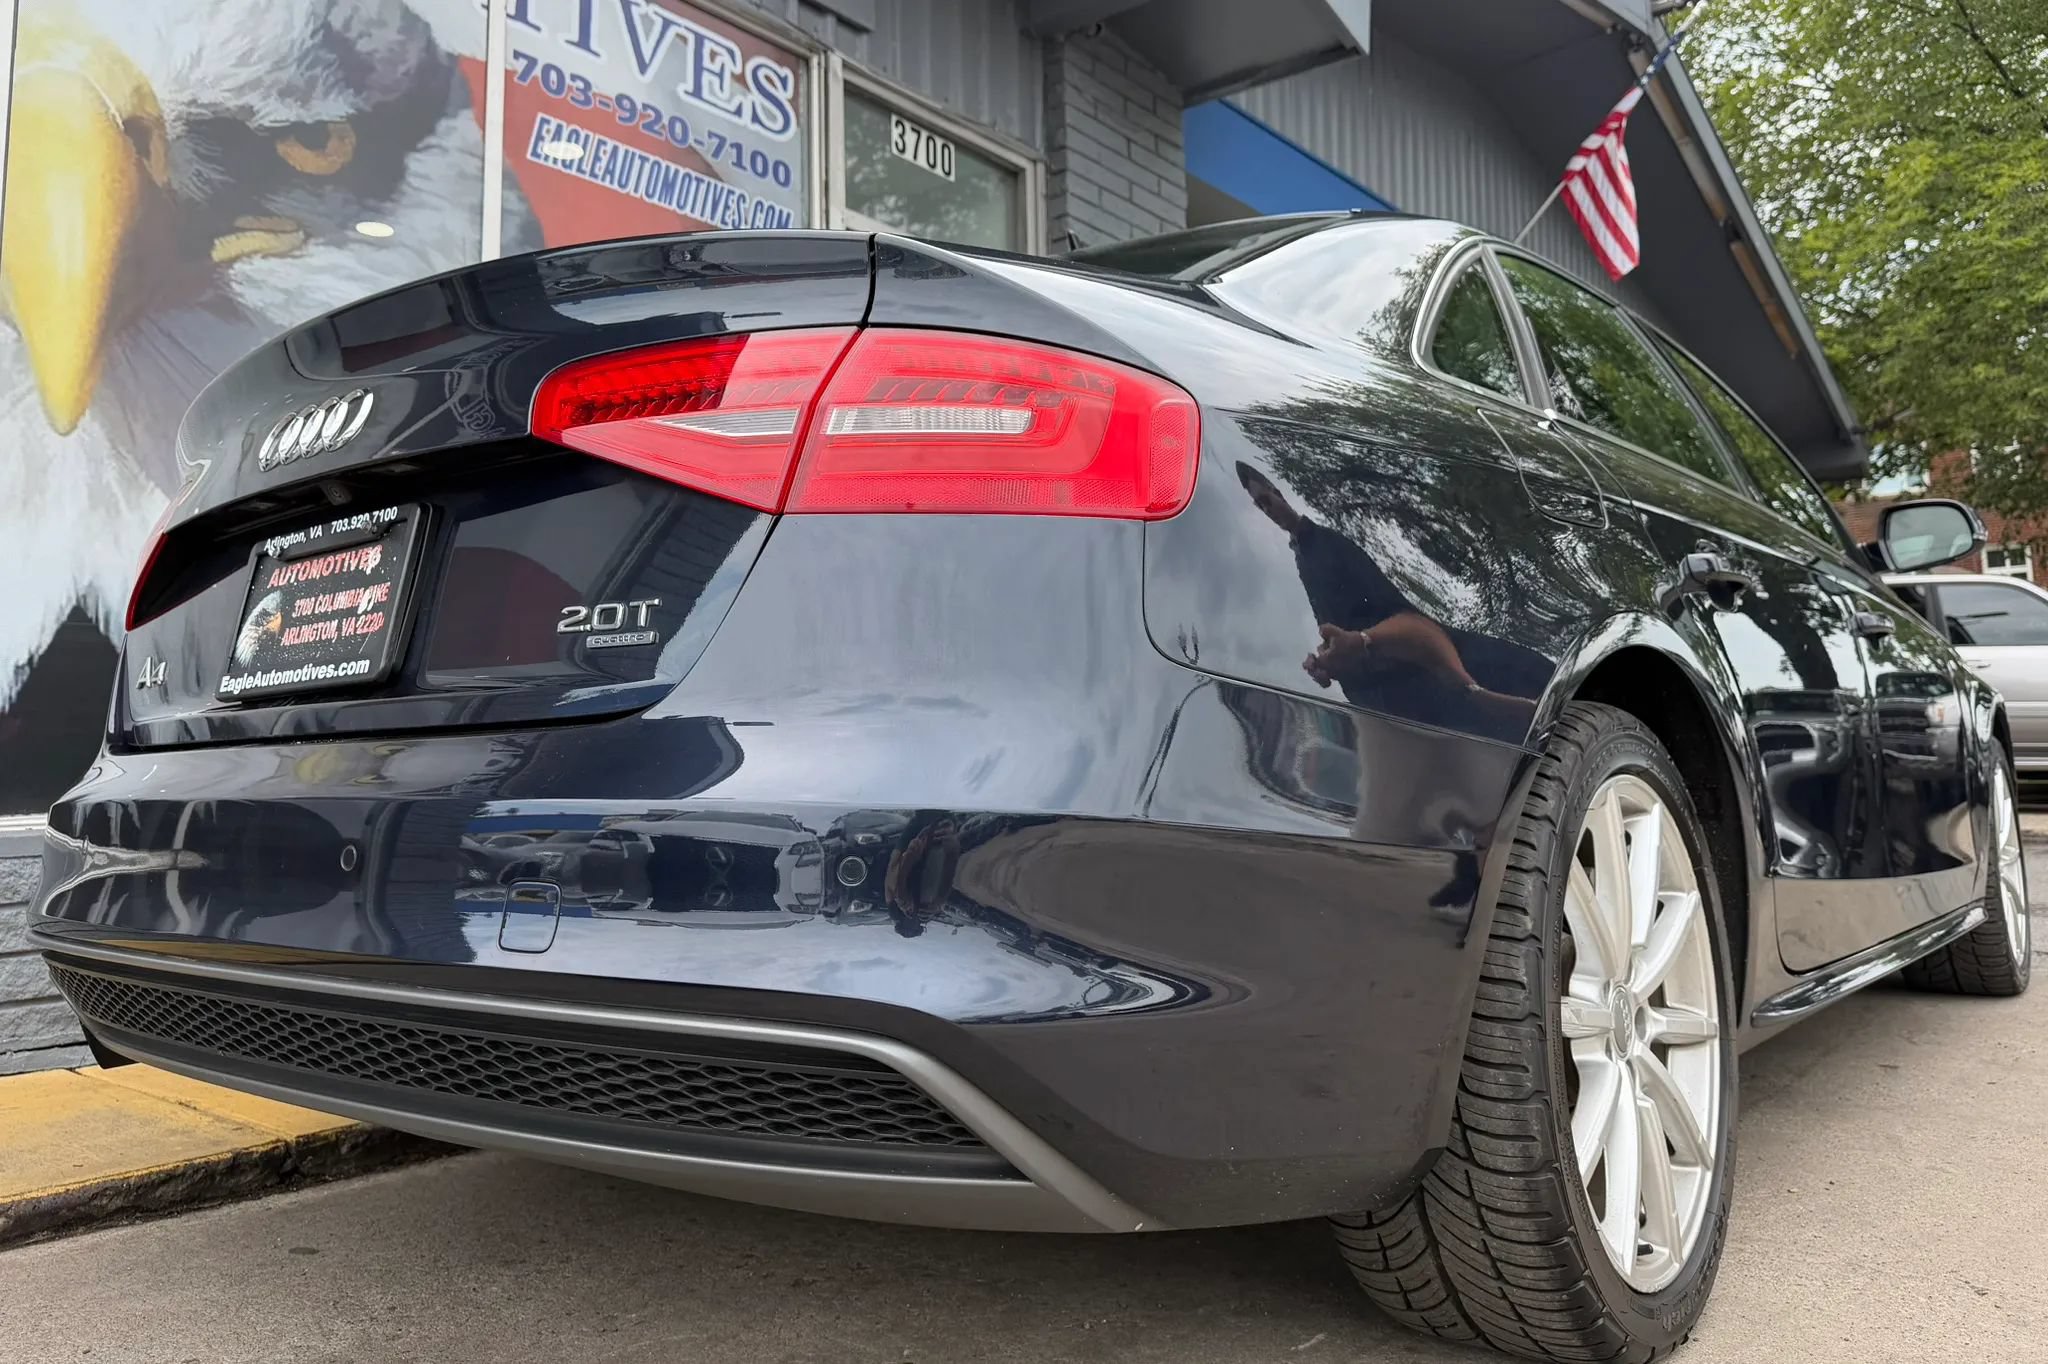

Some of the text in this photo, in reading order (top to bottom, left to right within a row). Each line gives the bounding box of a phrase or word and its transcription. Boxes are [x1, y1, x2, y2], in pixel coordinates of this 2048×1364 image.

[513, 49, 792, 188] 703-920-7100
[895, 120, 951, 176] 3700
[530, 116, 792, 229] EAGLEAUTOMOTIVESCOM
[309, 524, 323, 539] VA
[330, 506, 398, 534] 703.9207100
[341, 616, 356, 636] VA
[136, 656, 167, 689] A4
[219, 658, 370, 695] EagleAutomotives.com
